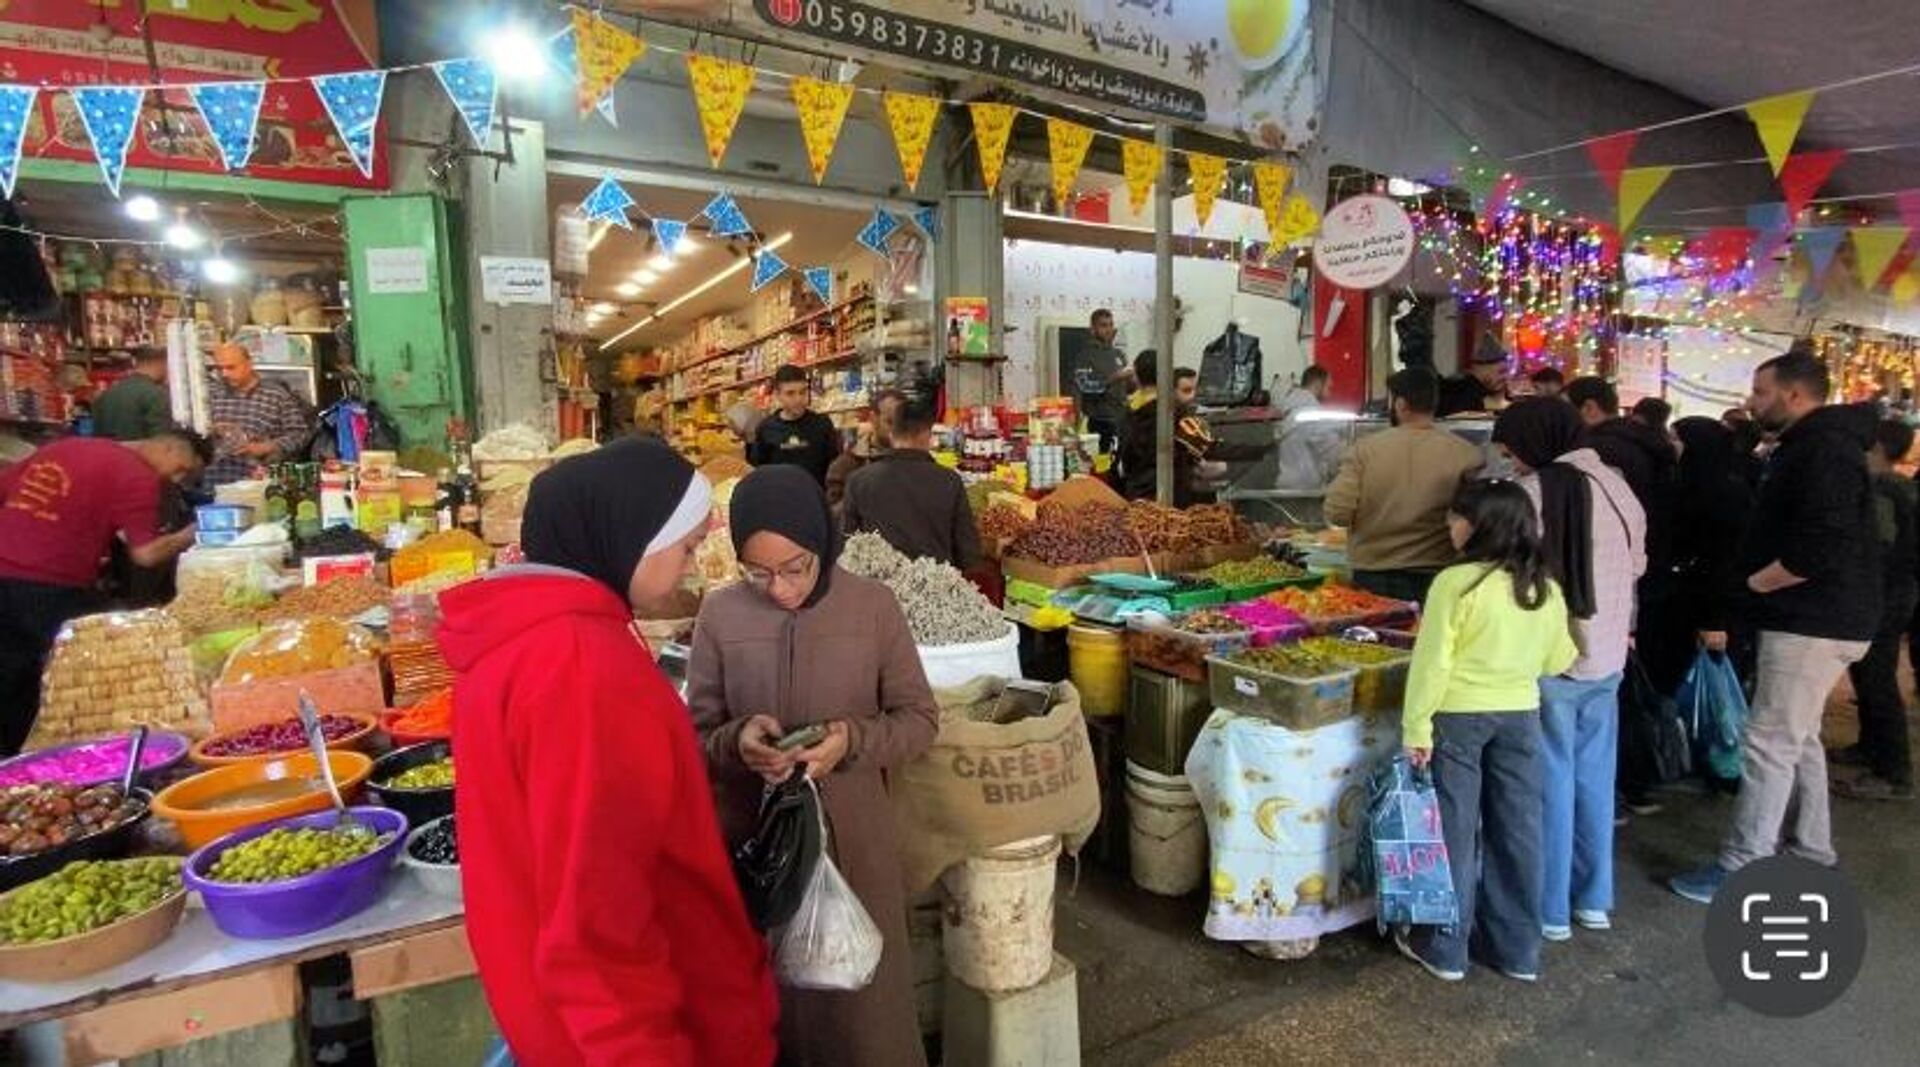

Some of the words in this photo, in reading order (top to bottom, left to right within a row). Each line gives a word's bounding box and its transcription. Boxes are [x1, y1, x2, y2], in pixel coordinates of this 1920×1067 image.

[805, 0, 1000, 68] 0598373831
[1009, 53, 1064, 85] واخوانه
[1065, 64, 1105, 96] ياسين
[952, 747, 1055, 779] CAFÉS
[1060, 732, 1083, 762] DO
[982, 767, 1080, 804] BRASIL
